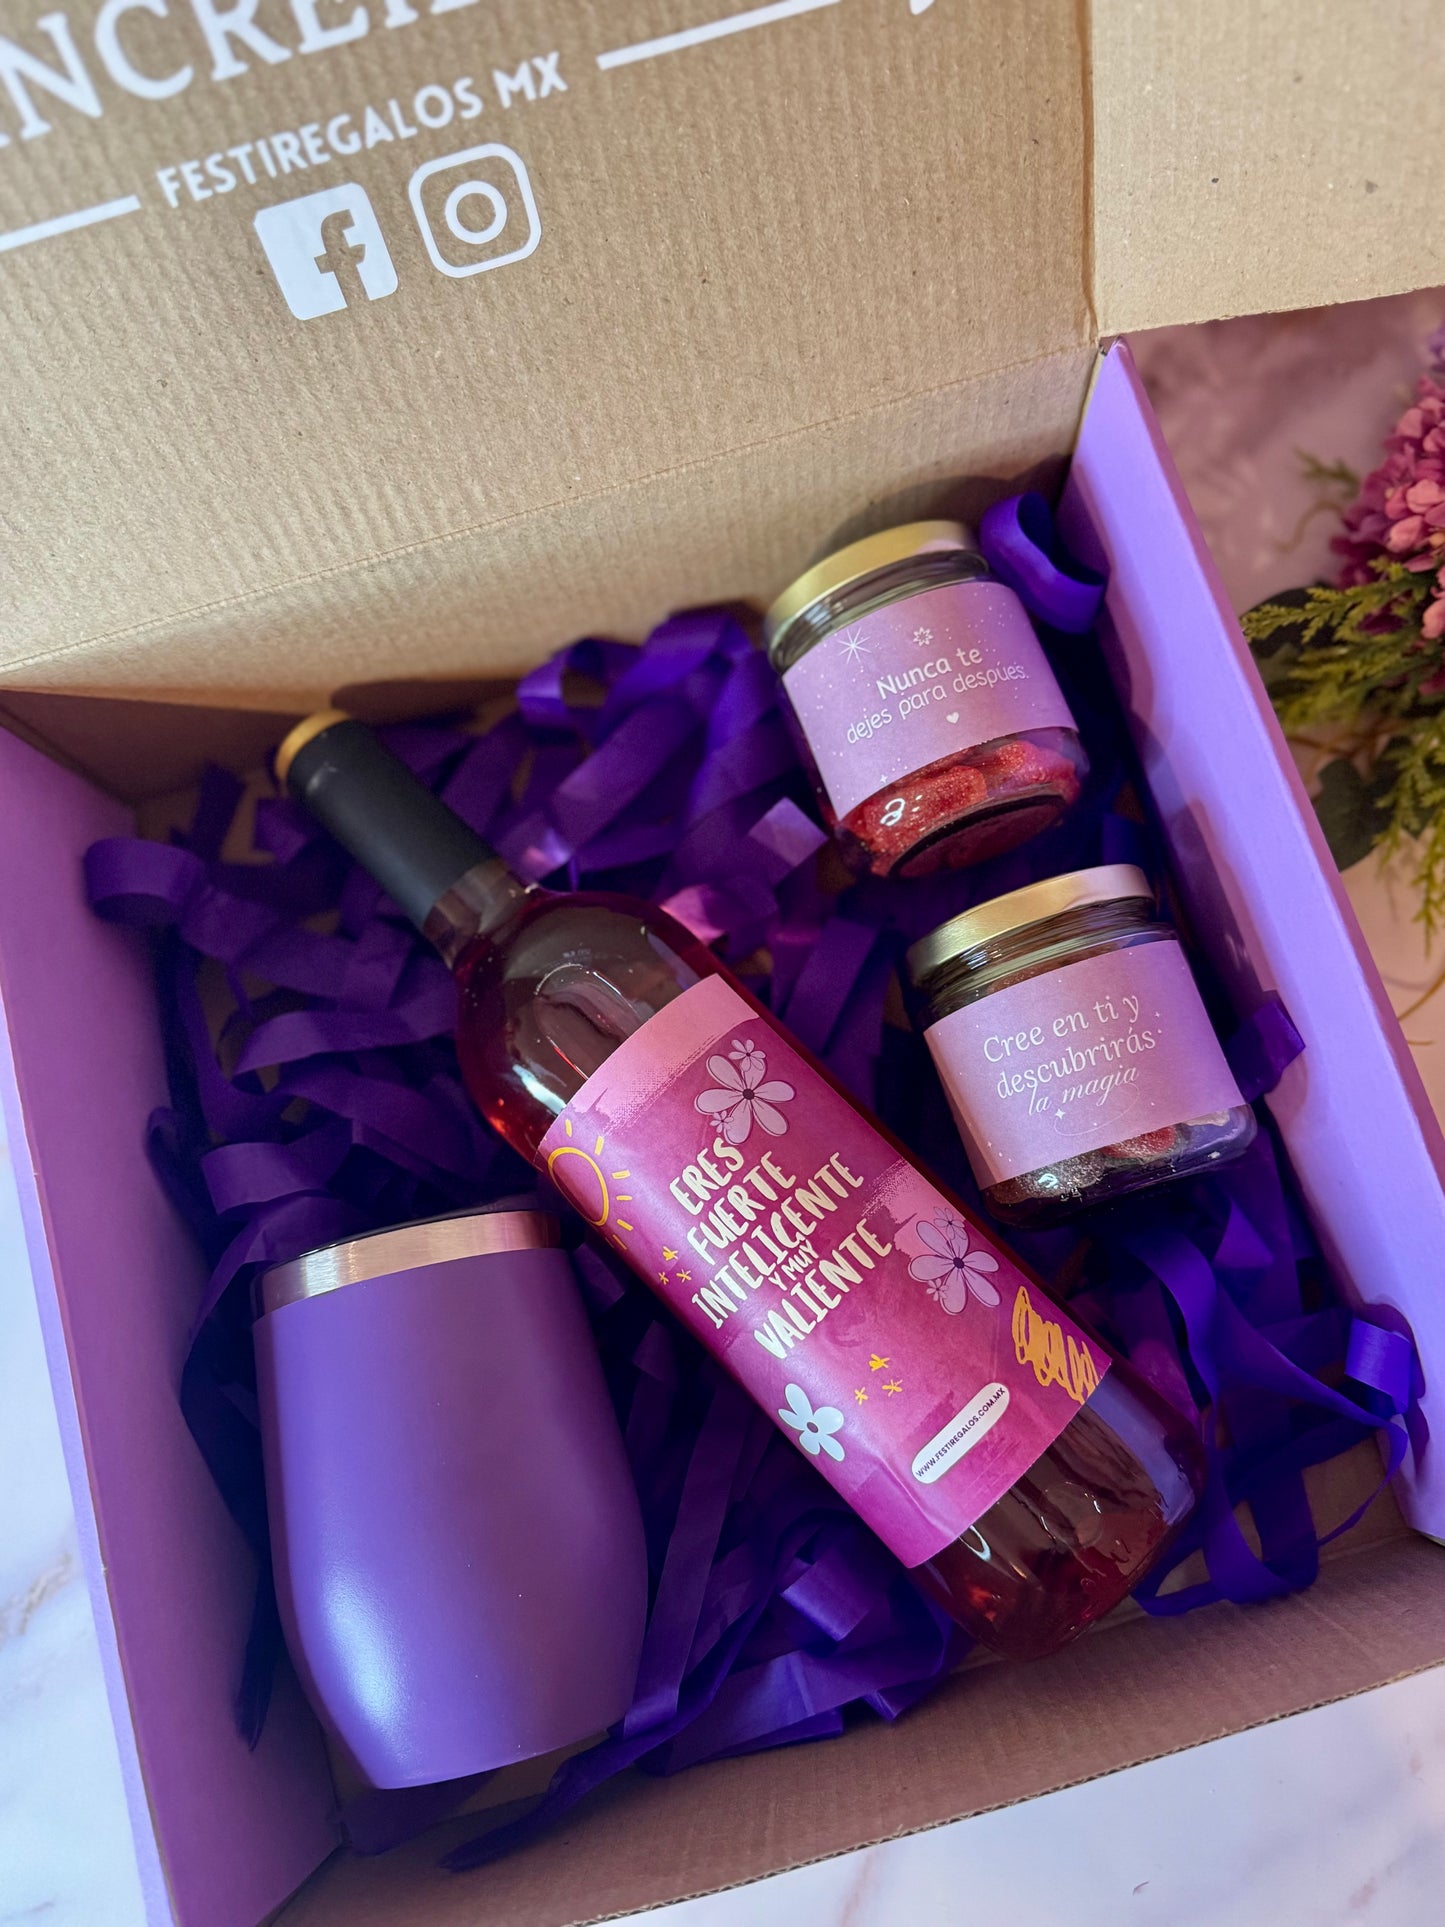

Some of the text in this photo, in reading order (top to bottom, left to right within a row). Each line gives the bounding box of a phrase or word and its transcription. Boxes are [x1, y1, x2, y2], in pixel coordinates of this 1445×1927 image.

[155, 50, 569, 209] FESTIREGALOS MX
[875, 647, 983, 700] Nunca te
[846, 709, 893, 745] dejes
[898, 683, 948, 720] para
[983, 994, 1140, 1064] Cree en ti y
[996, 1026, 1156, 1099] descubrirás
[1028, 1064, 1140, 1116] la magia
[669, 1136, 745, 1216] ERES
[686, 1150, 796, 1266] FUERTE
[753, 1217, 893, 1360] VALIENTE
[768, 1239, 819, 1291] Y MUY
[915, 1386, 1006, 1478] WWW.FESTIREGALOS.COM.MX
